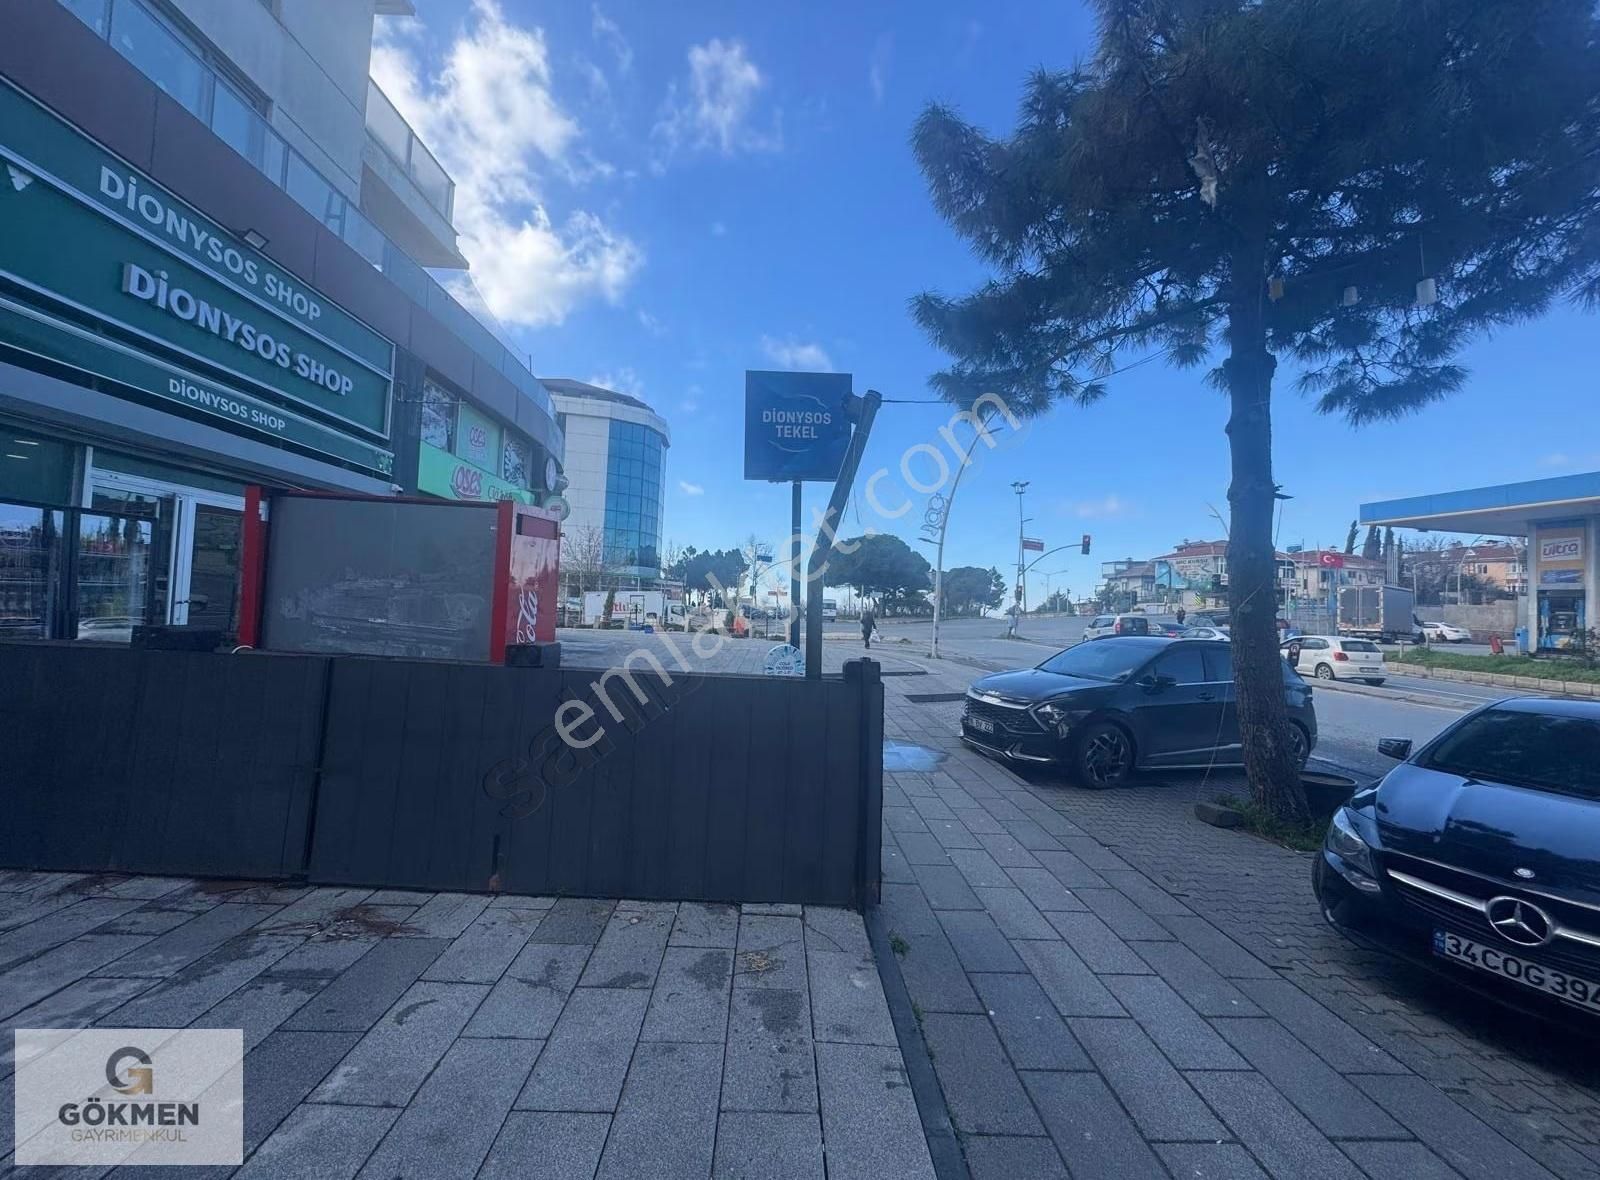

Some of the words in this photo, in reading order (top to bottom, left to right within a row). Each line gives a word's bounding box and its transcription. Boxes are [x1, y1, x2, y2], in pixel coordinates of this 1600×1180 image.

[264, 273, 321, 321] SHOP
[294, 353, 353, 397] SHOP
[251, 408, 286, 431] SHOP
[776, 425, 818, 439] TEKEL
